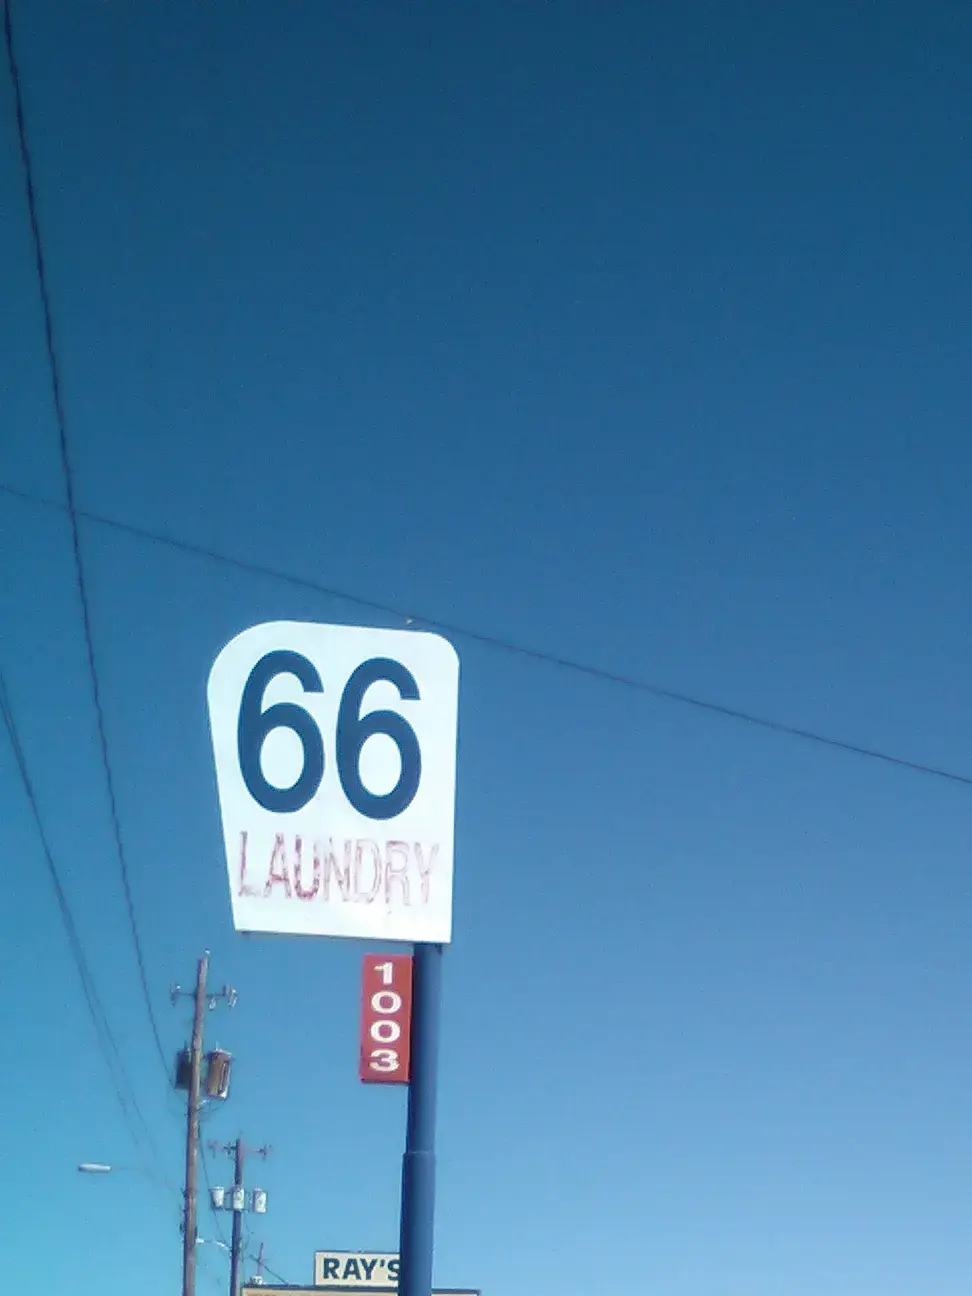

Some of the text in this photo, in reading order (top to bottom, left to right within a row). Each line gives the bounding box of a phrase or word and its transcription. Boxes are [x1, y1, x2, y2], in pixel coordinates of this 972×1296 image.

[237, 649, 422, 821] 66
[237, 831, 440, 906] LAUNDRY
[369, 961, 402, 1072] 1003
[322, 1257, 400, 1281] RAY'S
